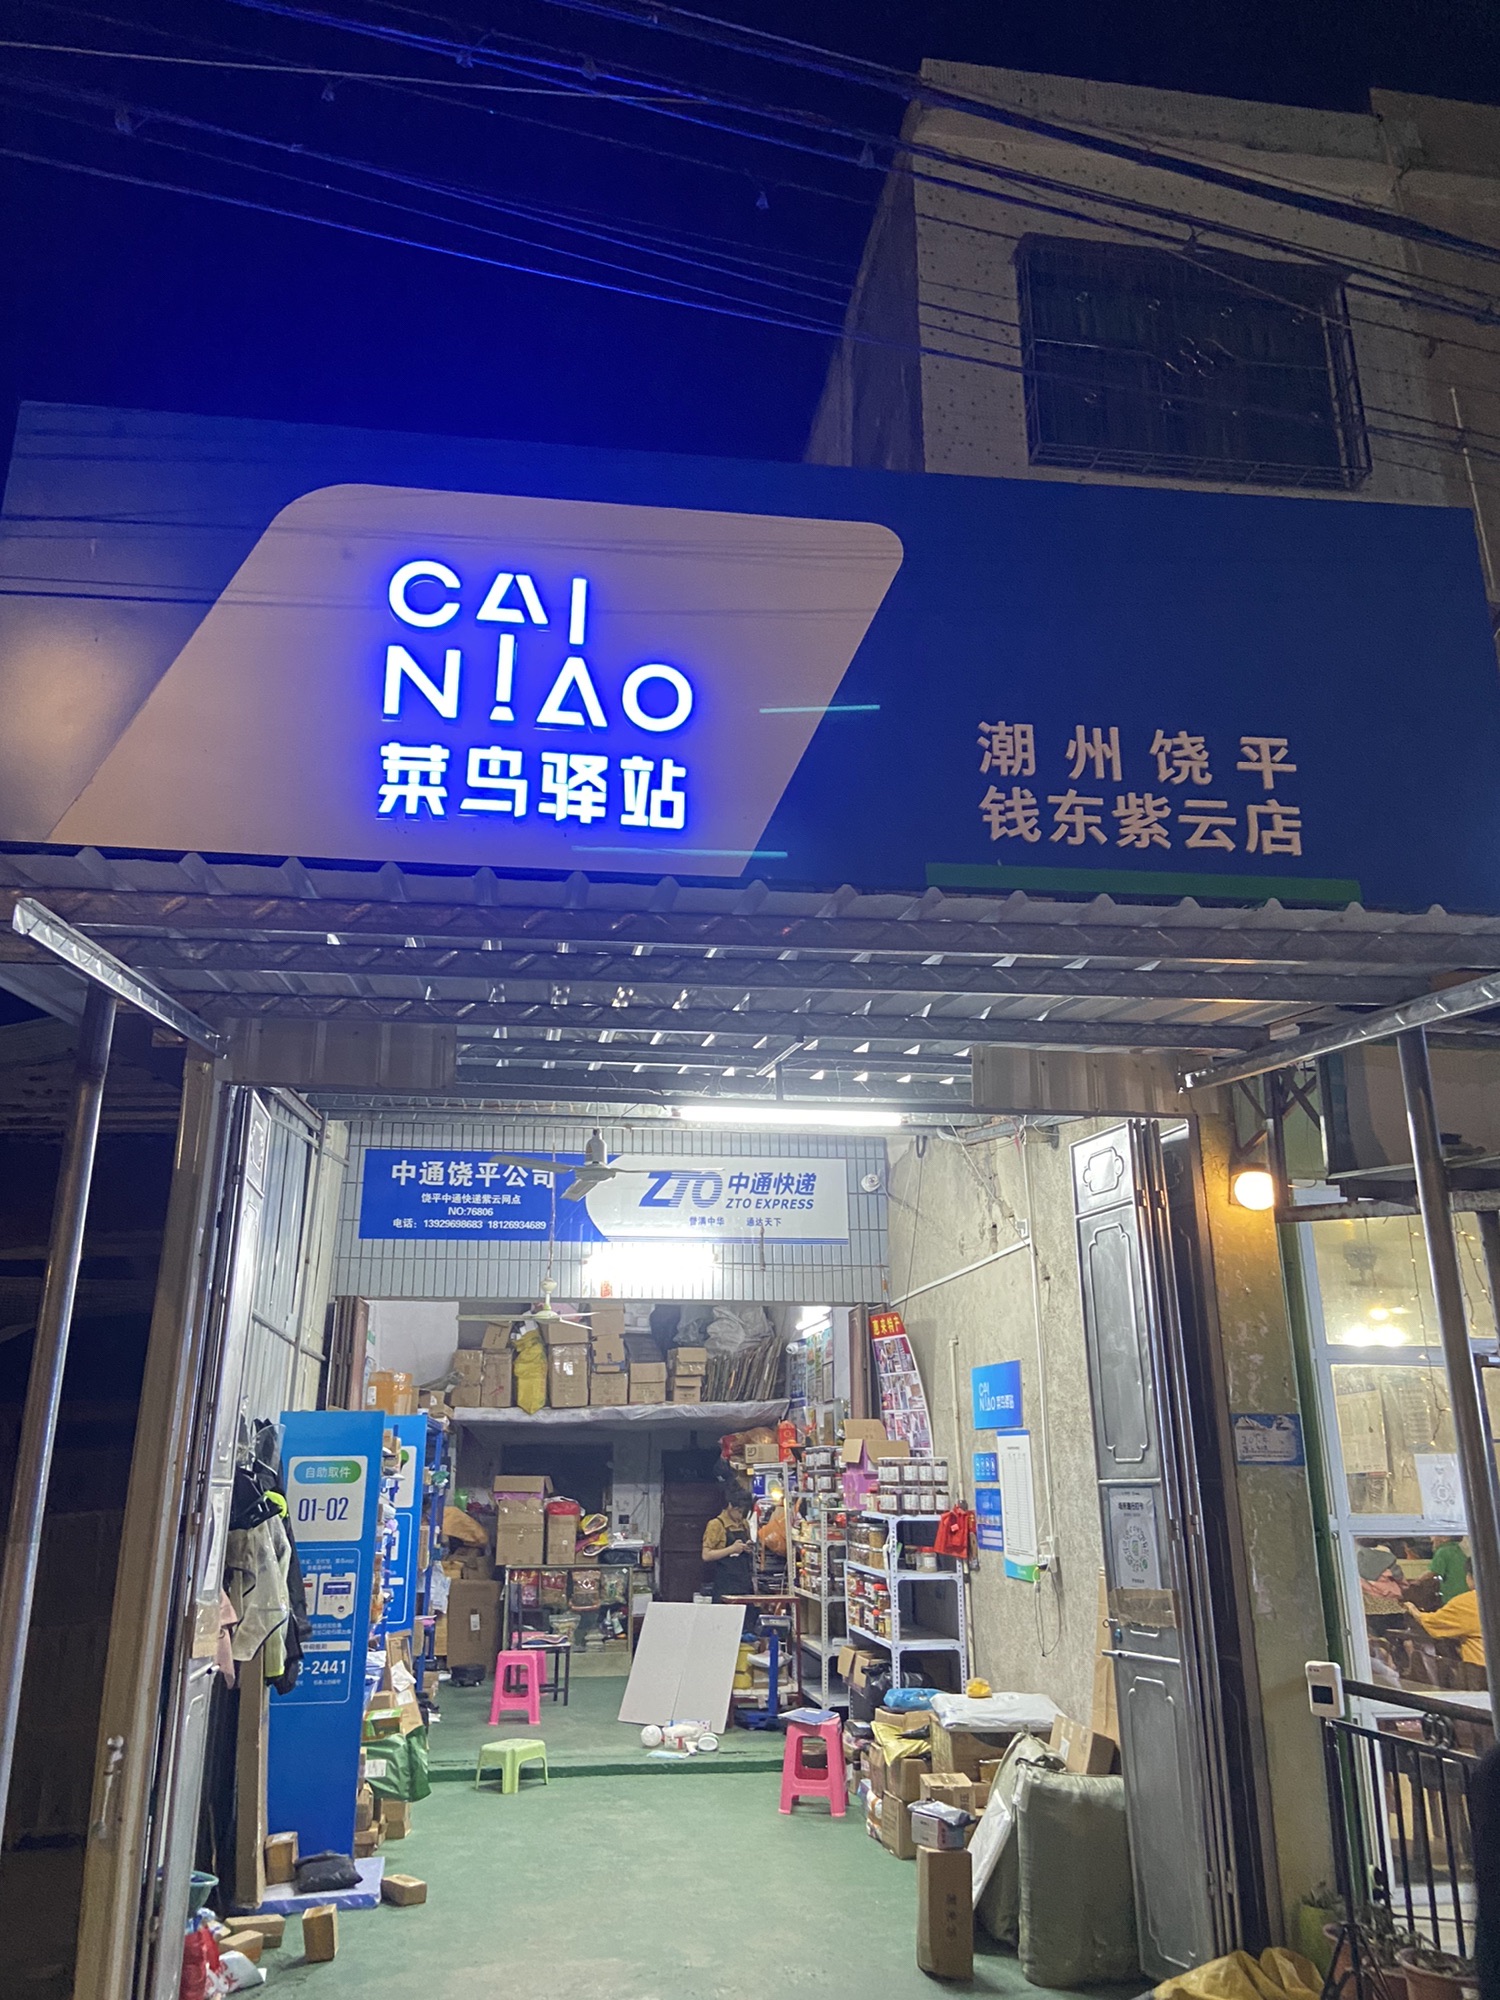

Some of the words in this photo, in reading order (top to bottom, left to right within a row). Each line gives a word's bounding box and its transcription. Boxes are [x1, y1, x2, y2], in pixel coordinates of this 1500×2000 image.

[388, 559, 588, 646] CAI
[977, 720, 1298, 790] 潮州饶平
[376, 741, 688, 830] 菜鸟驿站
[978, 784, 1303, 856] 钱东紫云店
[391, 1159, 556, 1189] 中通饶平公司
[727, 1171, 817, 1196] 中通快递
[421, 1193, 522, 1205] 饶平中通快递紫云网点
[638, 1171, 723, 1209] ZTO
[725, 1198, 752, 1210] ZTO
[754, 1199, 814, 1211] EXPRESS
[447, 1206, 494, 1217] NO:76806
[305, 1466, 352, 1478] 自助取件
